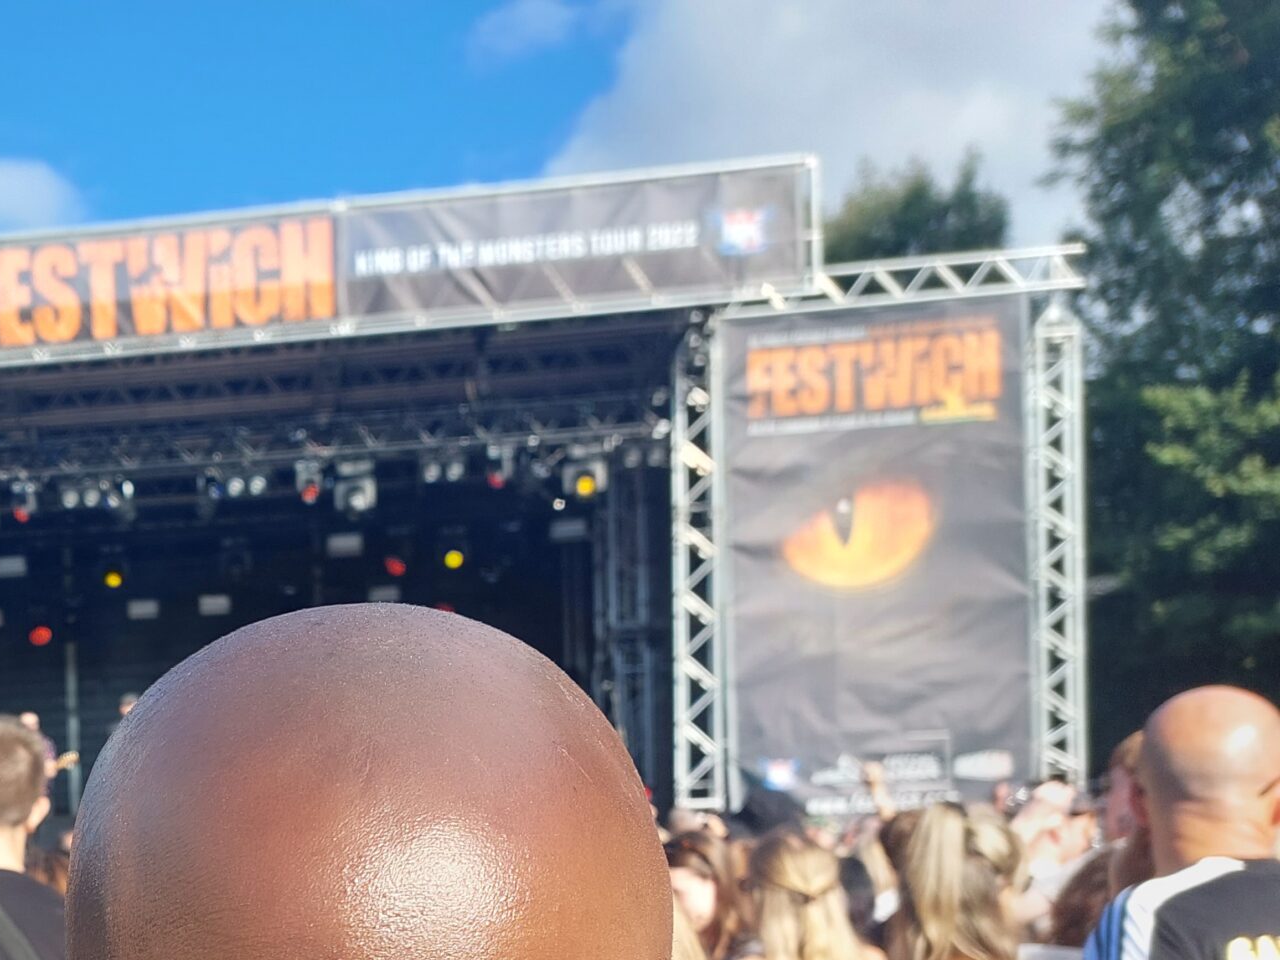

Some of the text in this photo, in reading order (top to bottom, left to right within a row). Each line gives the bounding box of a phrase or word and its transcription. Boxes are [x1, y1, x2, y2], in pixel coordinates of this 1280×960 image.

[406, 243, 431, 273] OF
[478, 231, 587, 266] MONSTERS
[590, 225, 643, 256] TOUR
[746, 328, 1004, 420] FESTWICH
